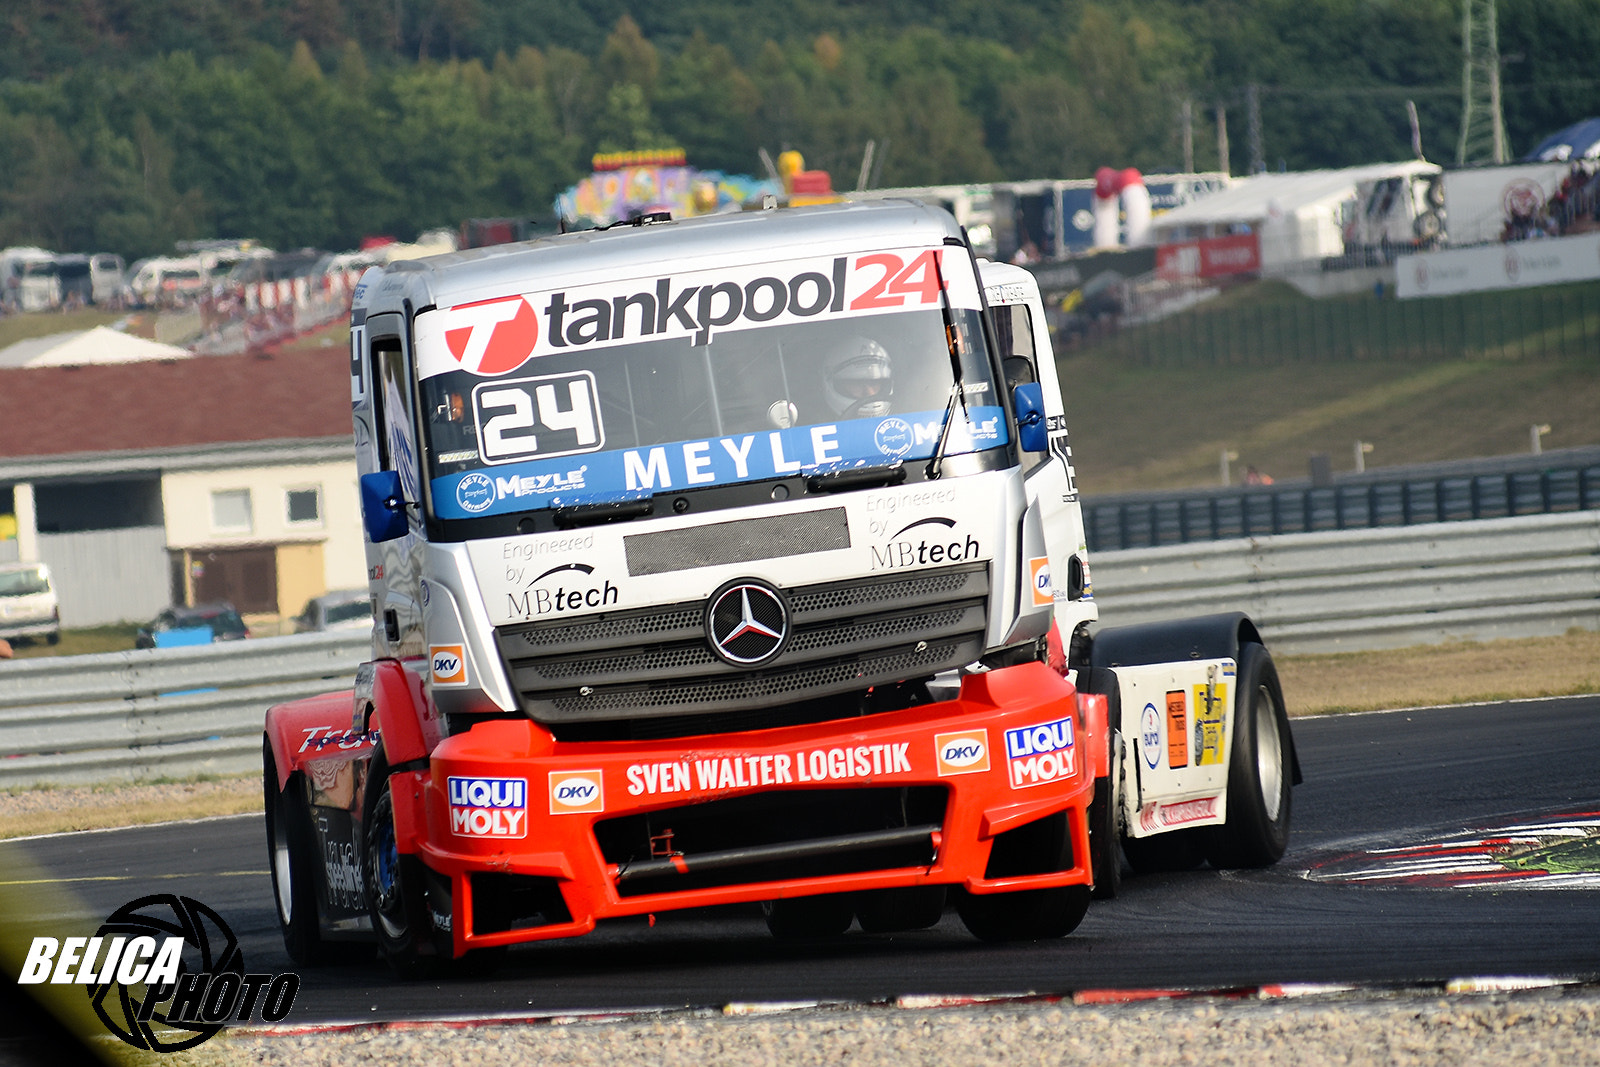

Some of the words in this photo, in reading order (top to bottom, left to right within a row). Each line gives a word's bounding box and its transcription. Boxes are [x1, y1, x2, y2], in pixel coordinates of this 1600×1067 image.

[480, 379, 597, 457] 24
[913, 419, 997, 446] MLE
[623, 425, 842, 491] MEYLE
[460, 474, 491, 491] MEYLE
[496, 469, 585, 500] MEYLE
[866, 486, 956, 513] Engineered
[869, 517, 888, 537] by
[503, 532, 594, 560] Engineered
[870, 534, 979, 570] MBtech
[506, 565, 525, 584] by
[506, 580, 618, 618] MBtech
[434, 659, 457, 671] DKV
[945, 745, 980, 760] DKV
[1009, 720, 1073, 757] LIQUI
[626, 761, 690, 795] SVEN
[695, 754, 792, 790] WALTER
[797, 743, 912, 782] LOGISTIK
[1013, 748, 1075, 785] MOLY
[451, 780, 523, 808] LIQUI
[558, 786, 594, 799] DKV
[453, 808, 524, 835] MOLY
